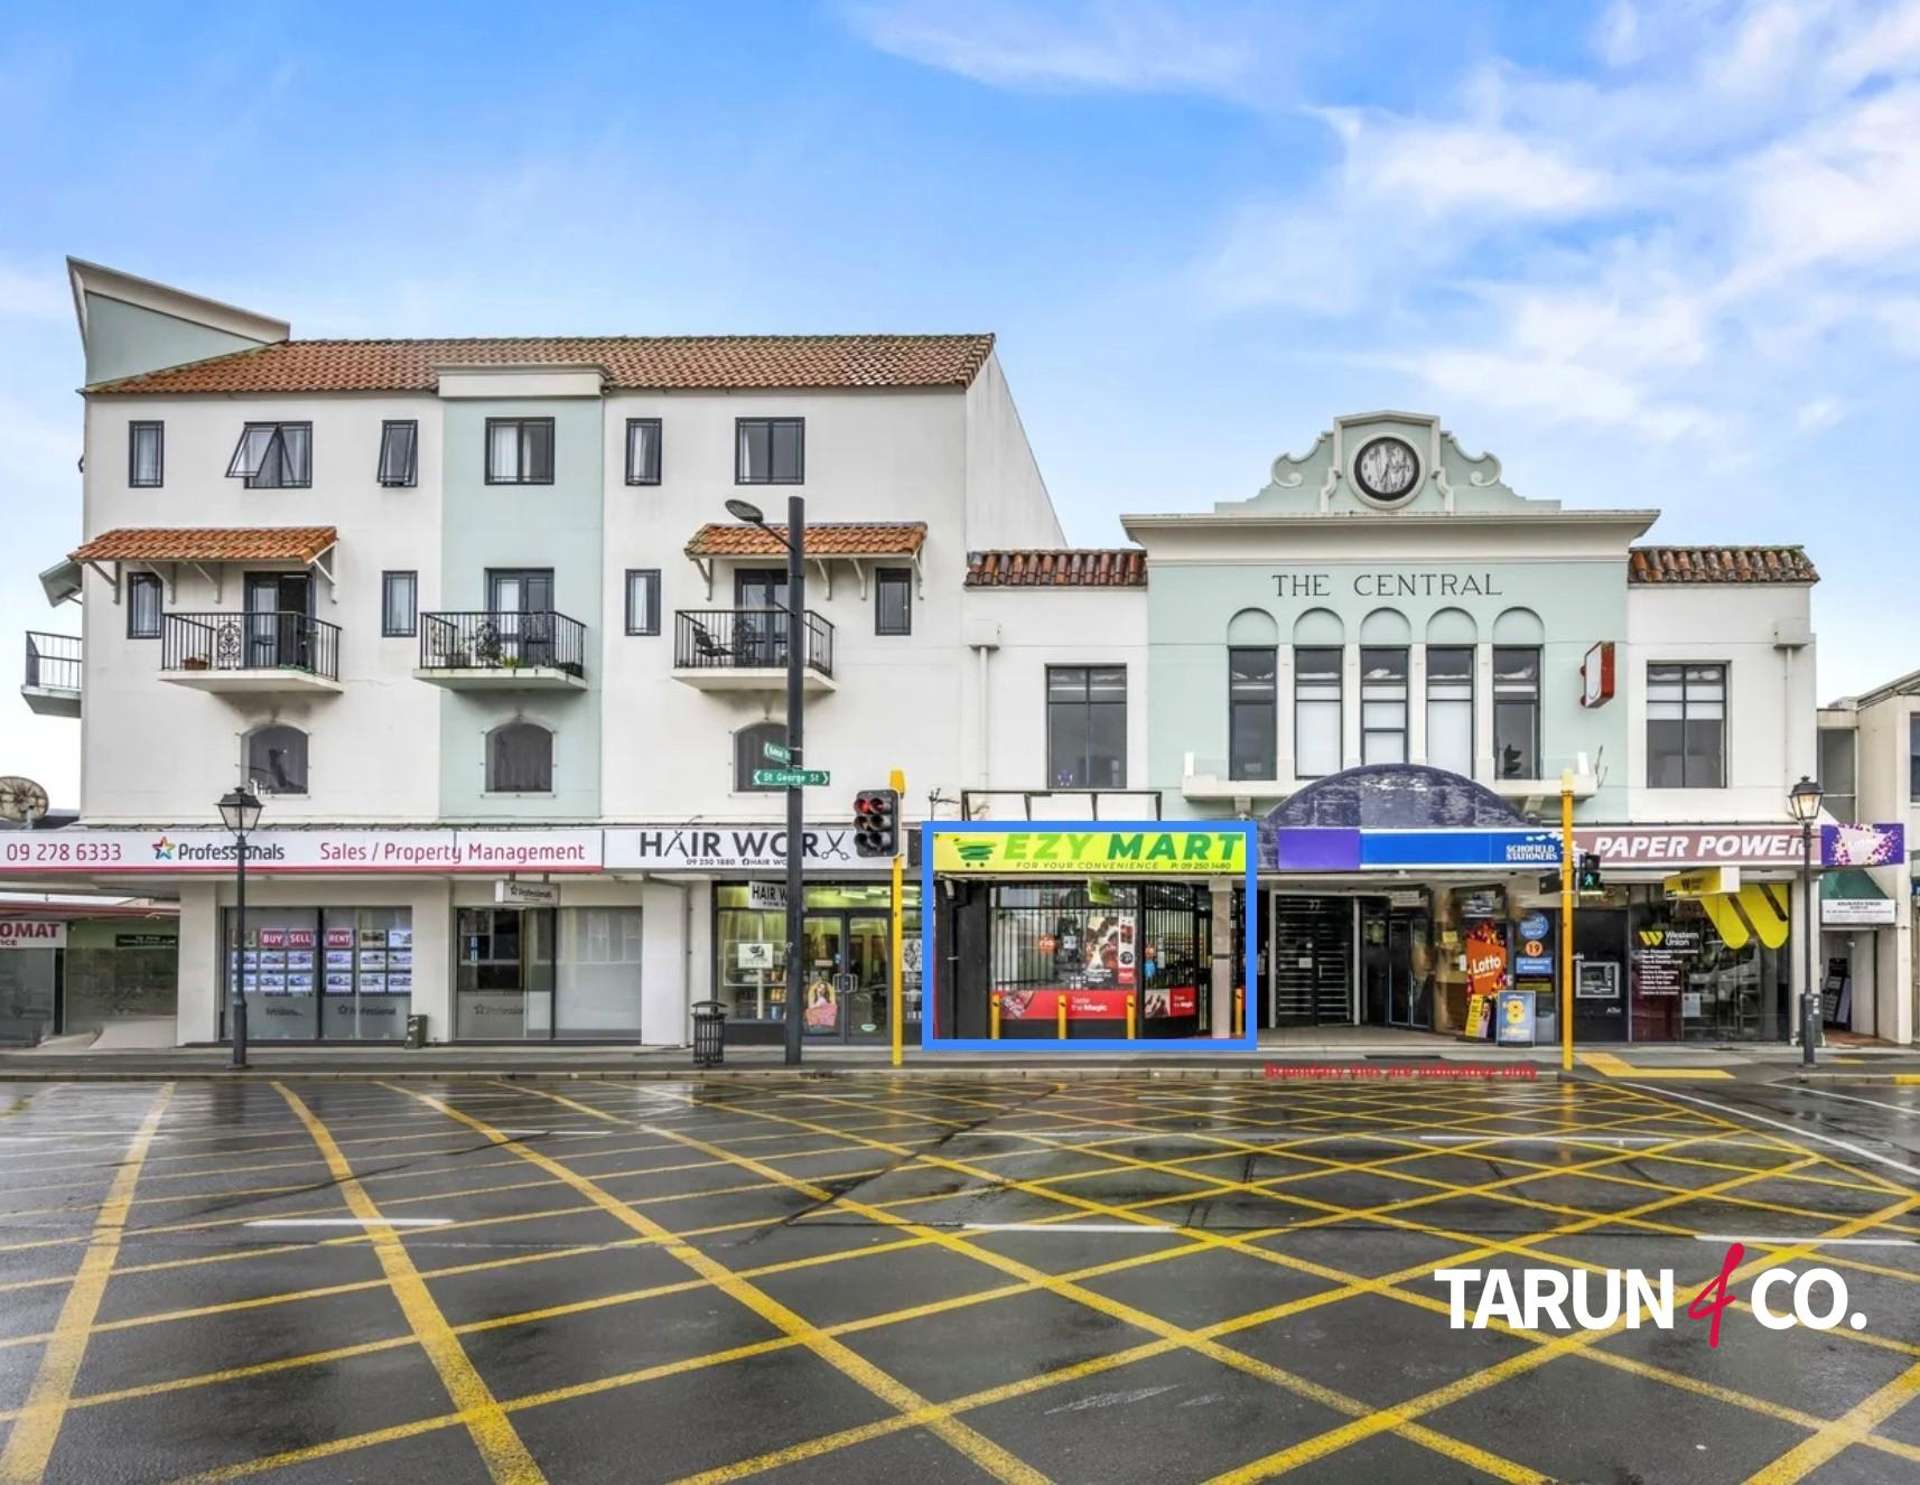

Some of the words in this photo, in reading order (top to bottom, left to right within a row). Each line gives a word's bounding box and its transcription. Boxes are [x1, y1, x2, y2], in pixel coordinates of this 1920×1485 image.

[1271, 574, 1330, 597] THE
[1353, 573, 1503, 597] CENTRAL
[6, 843, 34, 860] 09
[37, 843, 70, 860] 278
[76, 843, 122, 860] 6333
[178, 843, 285, 860] Professonals
[320, 842, 367, 860] Sales
[384, 842, 461, 864] Property
[469, 842, 585, 864] Management
[639, 831, 721, 857] HAIR
[1003, 832, 1098, 860] EZY
[1106, 833, 1245, 860] MART
[1593, 836, 1689, 858] PAPER
[1696, 834, 1805, 857] POWER
[1016, 862, 1039, 870] FOR
[1044, 862, 1073, 870] YOUR
[1077, 862, 1160, 870] CONVENIENCE
[752, 885, 776, 900] HAIR
[263, 934, 282, 944] BUY
[289, 934, 312, 943] SELL
[1472, 956, 1502, 974] Lotto
